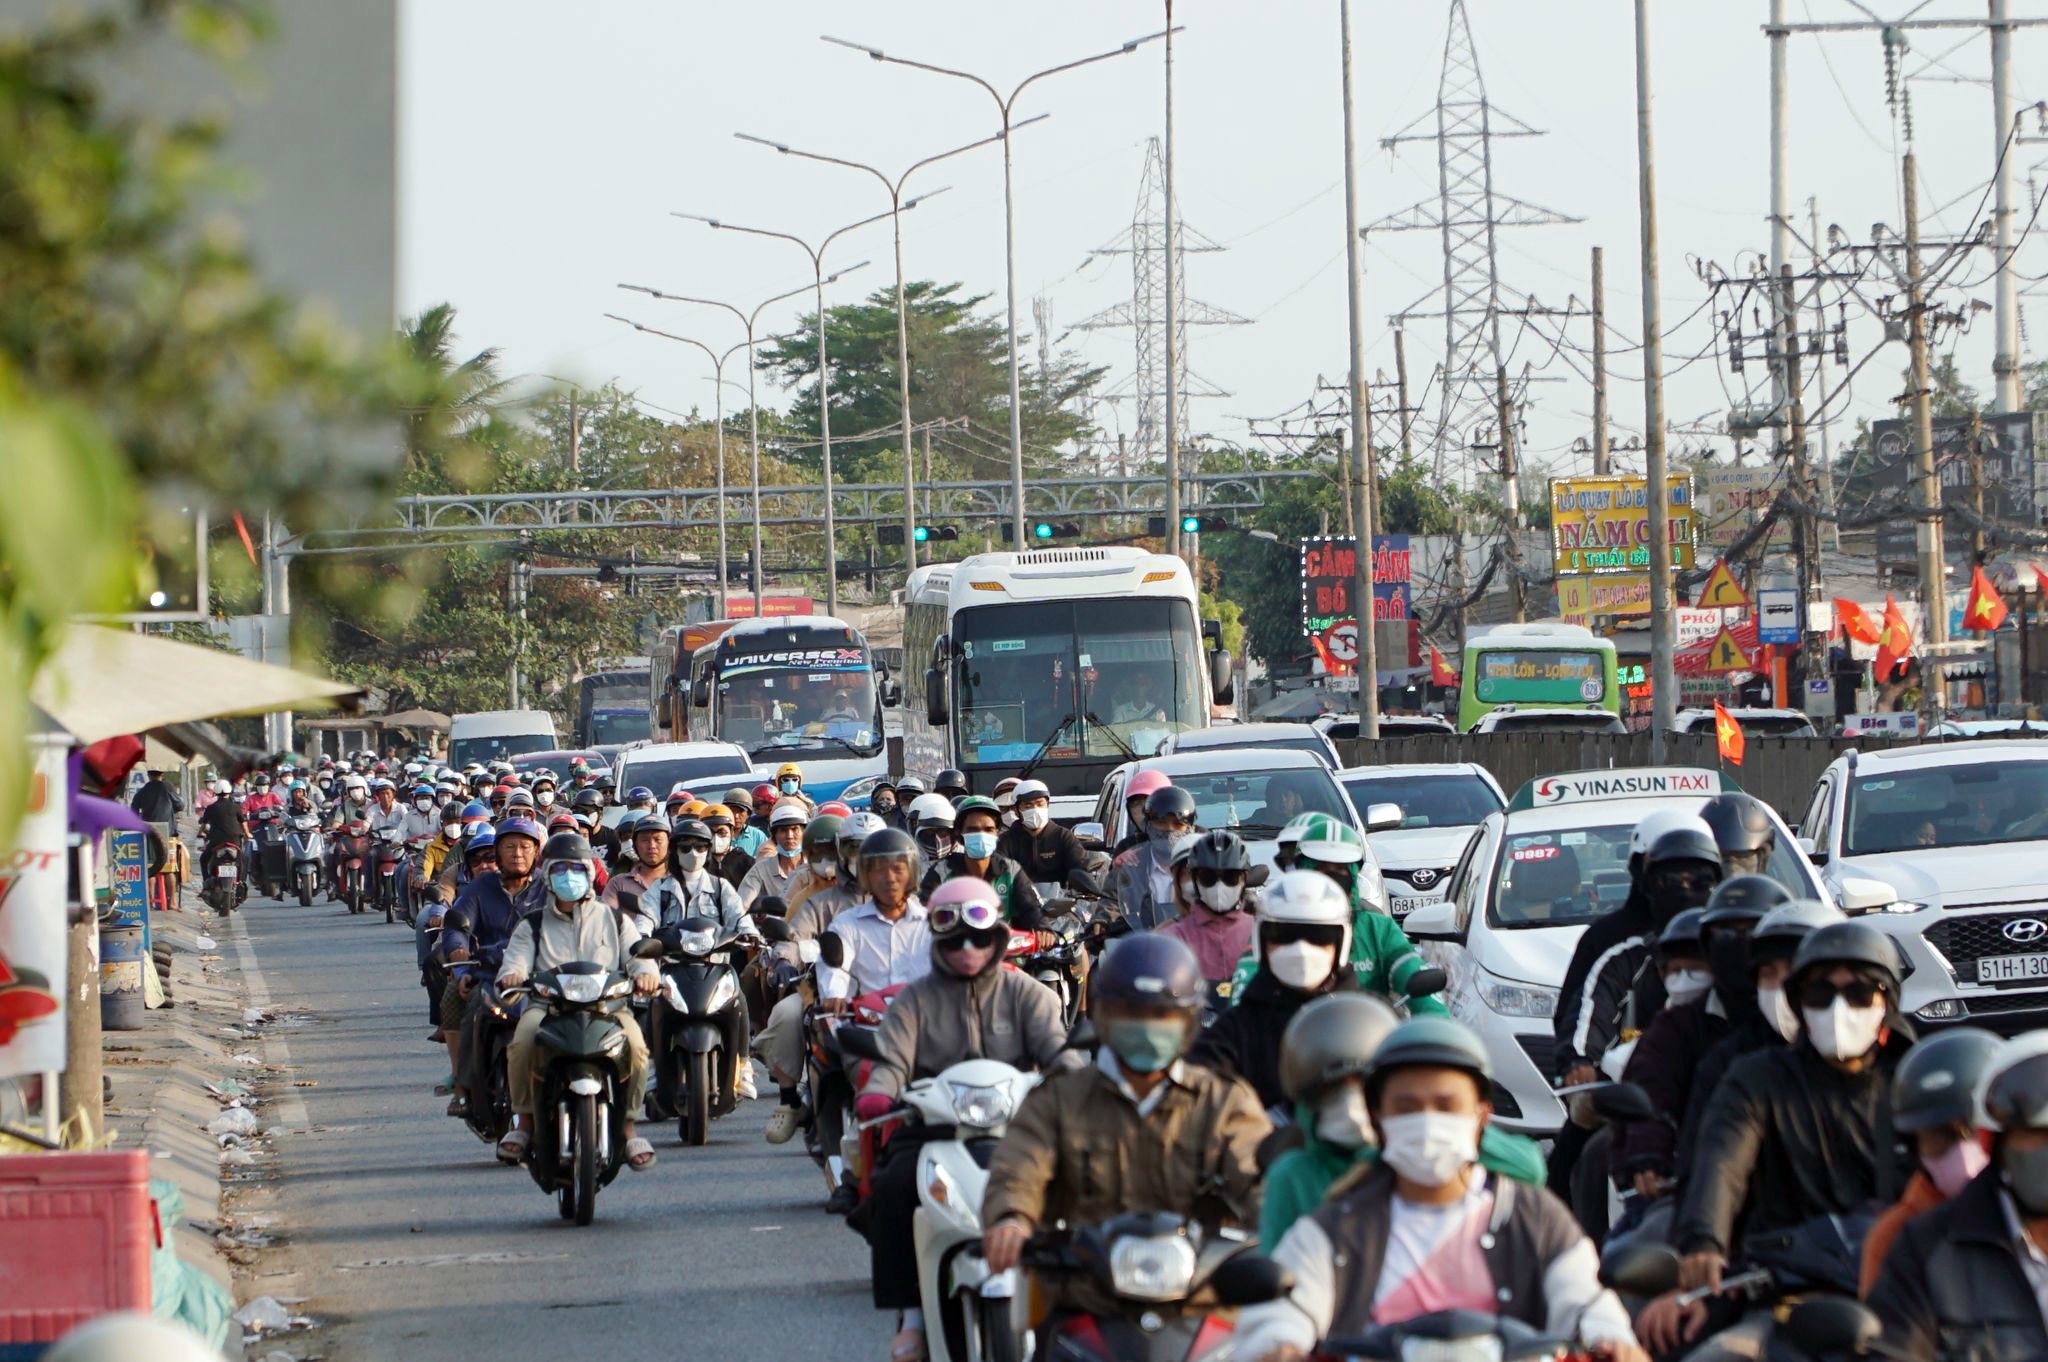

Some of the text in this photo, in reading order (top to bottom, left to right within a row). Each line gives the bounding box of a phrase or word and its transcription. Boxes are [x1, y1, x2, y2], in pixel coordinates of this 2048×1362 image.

[1579, 489, 1610, 511] QUAY
[1615, 482, 1633, 508] LÒ
[1561, 510, 1629, 548] NĂM
[1680, 609, 1716, 624] PHỞ
[1861, 717, 1888, 729] Bia
[1573, 774, 1709, 796] VINASUN TAXI
[115, 844, 140, 860] XE
[1514, 848, 1556, 860] 9987
